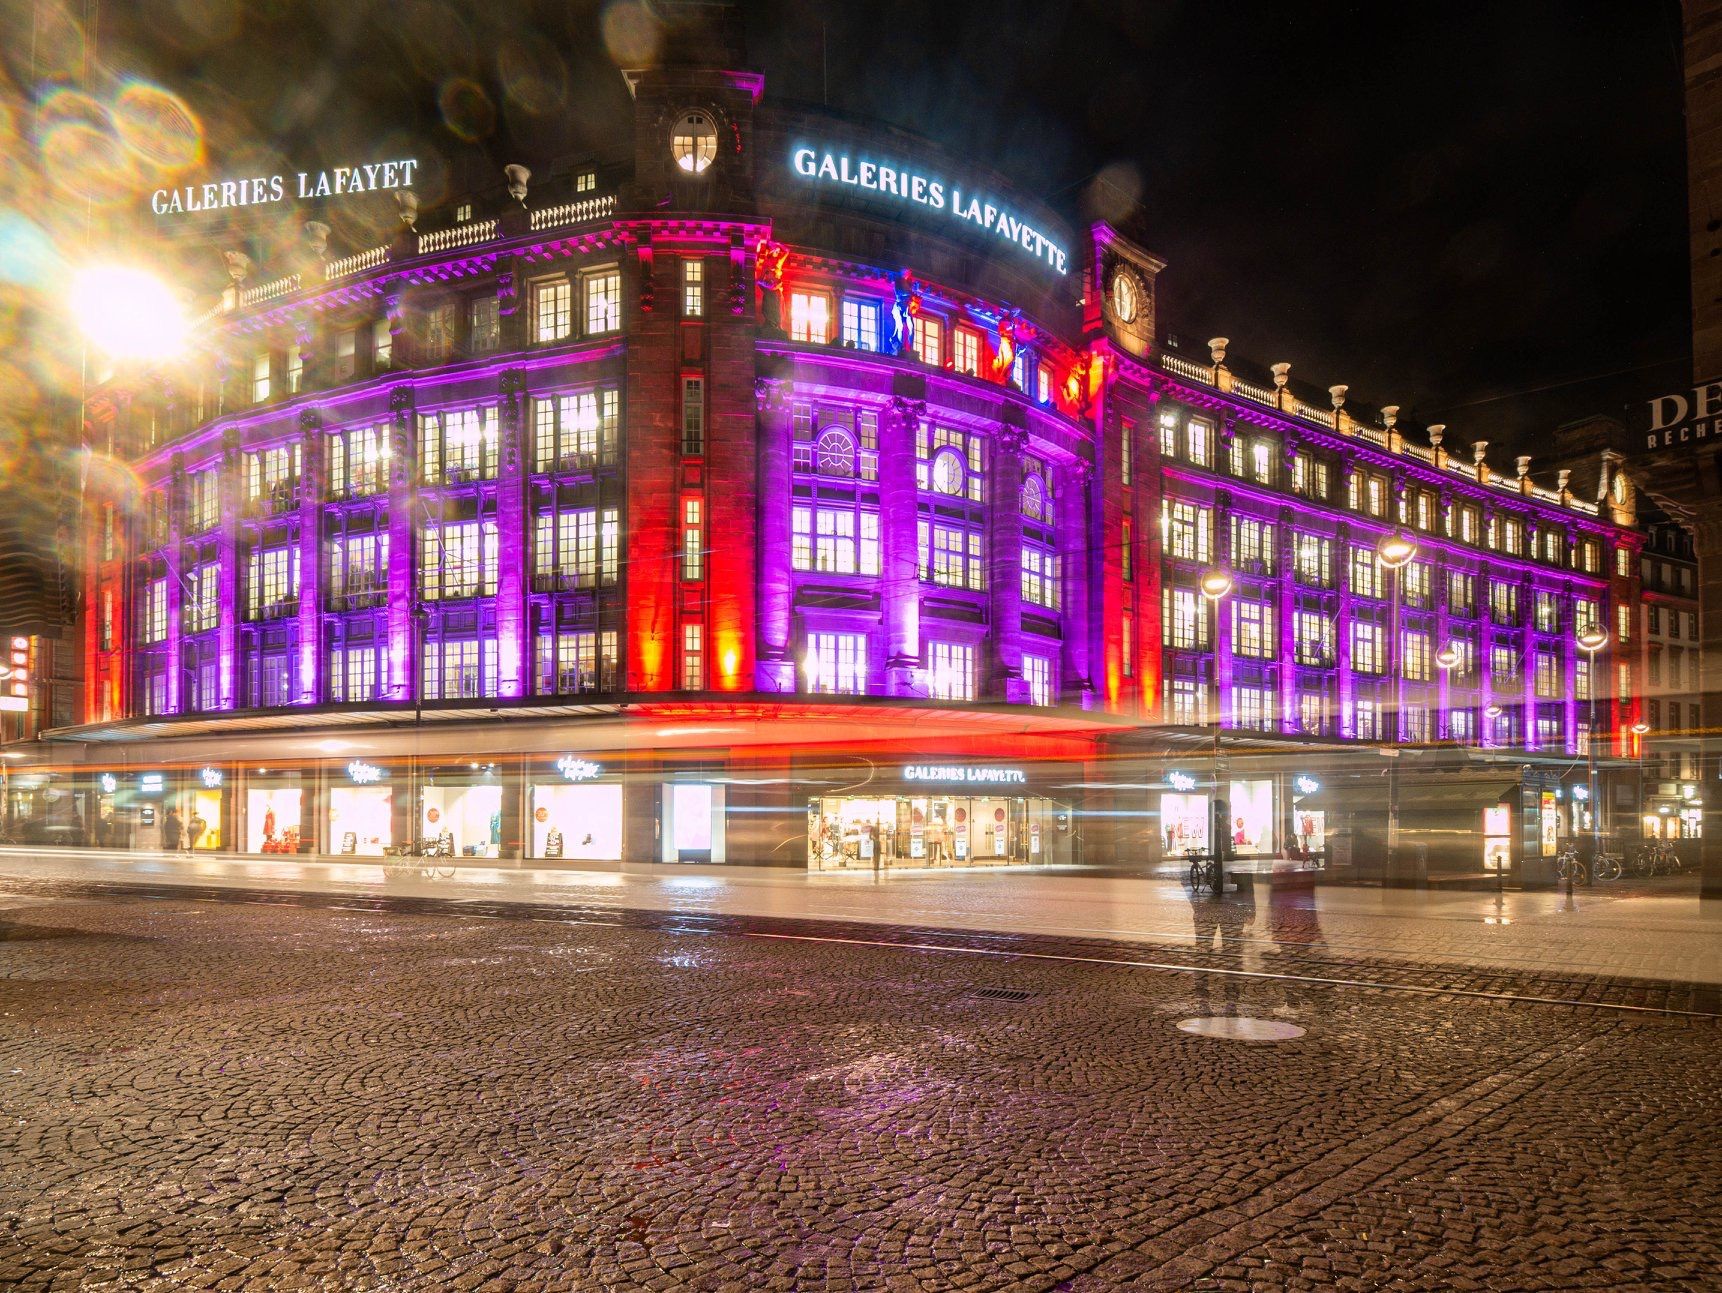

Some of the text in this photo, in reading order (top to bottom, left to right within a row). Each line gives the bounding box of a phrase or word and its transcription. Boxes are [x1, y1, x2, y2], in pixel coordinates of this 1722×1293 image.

[152, 159, 417, 215] GALERIES LAFAYET
[794, 148, 1067, 275] GALERIES LAFAYETTE
[904, 765, 965, 781] GALERIES
